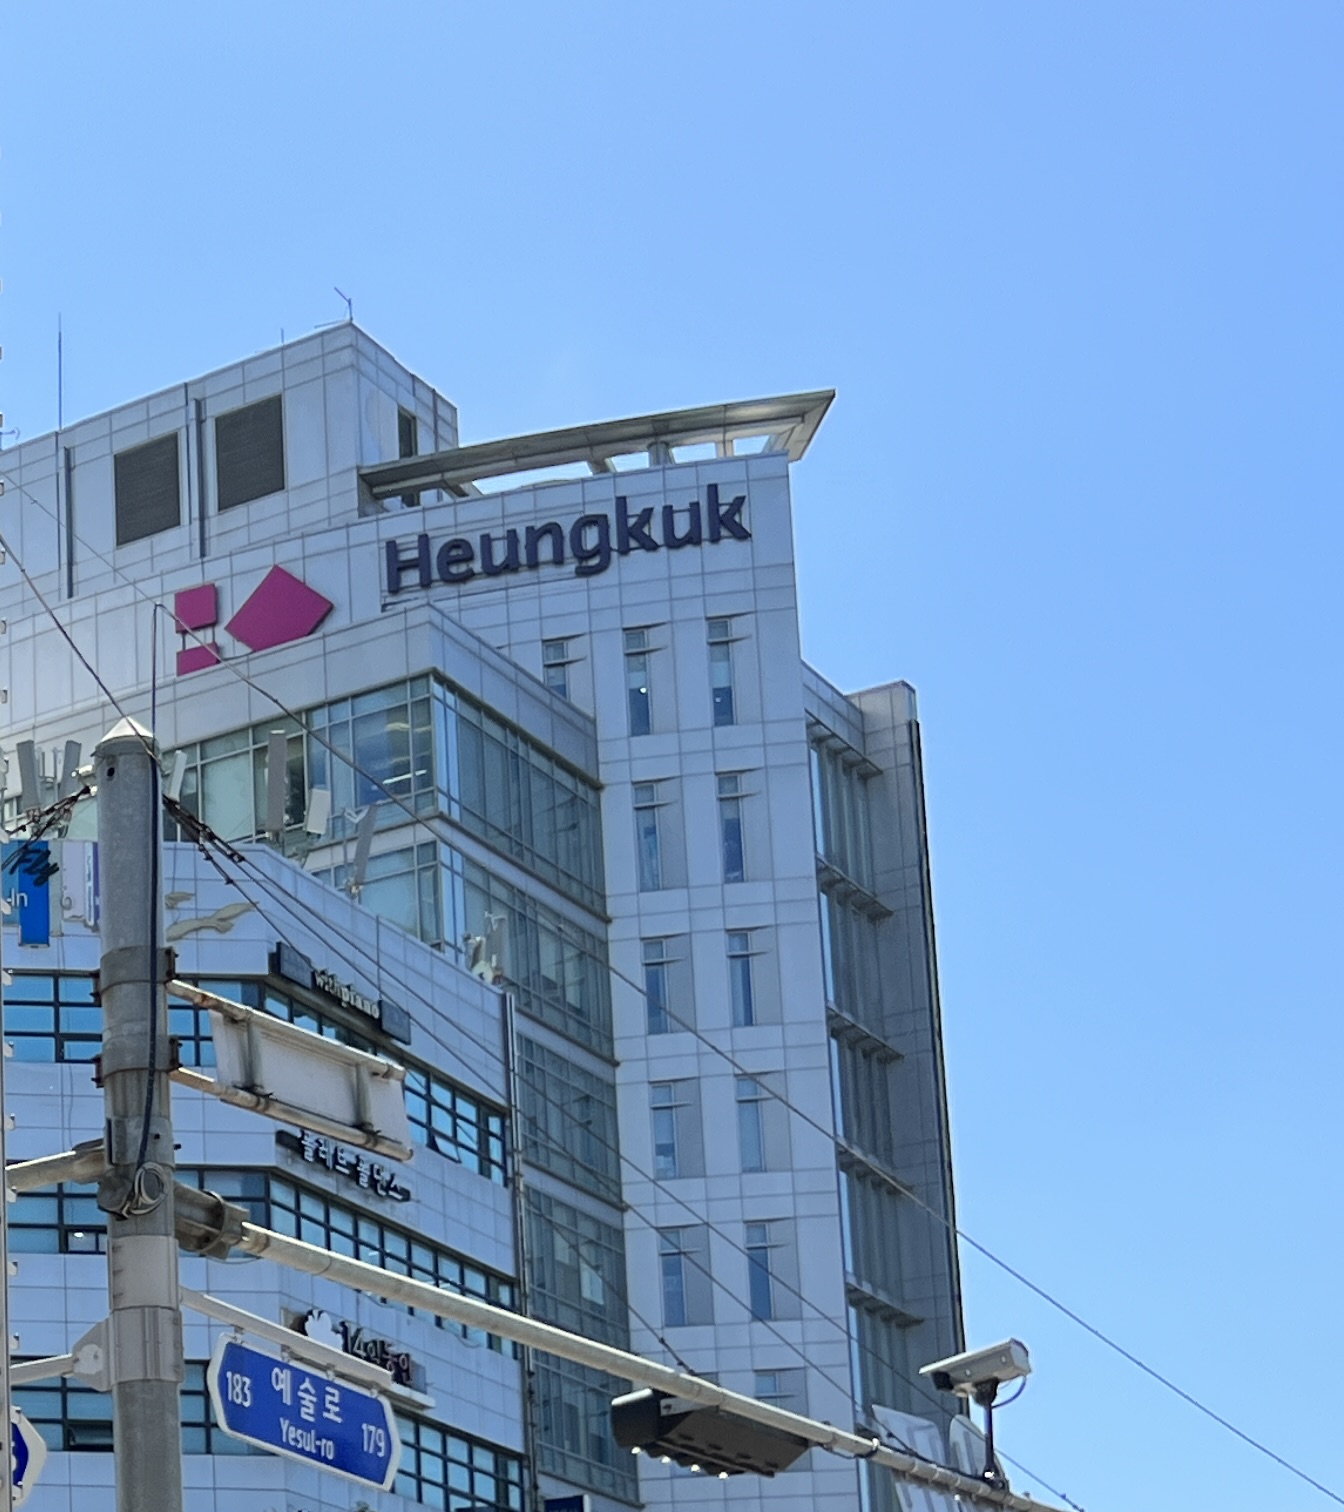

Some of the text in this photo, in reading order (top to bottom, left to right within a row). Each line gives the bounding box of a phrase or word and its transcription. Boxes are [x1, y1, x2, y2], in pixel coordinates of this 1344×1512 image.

[383, 482, 751, 595] Heungkuk
[225, 1366, 385, 1458] 183 예술로 179
[279, 1417, 335, 1460] Yesul-ro
